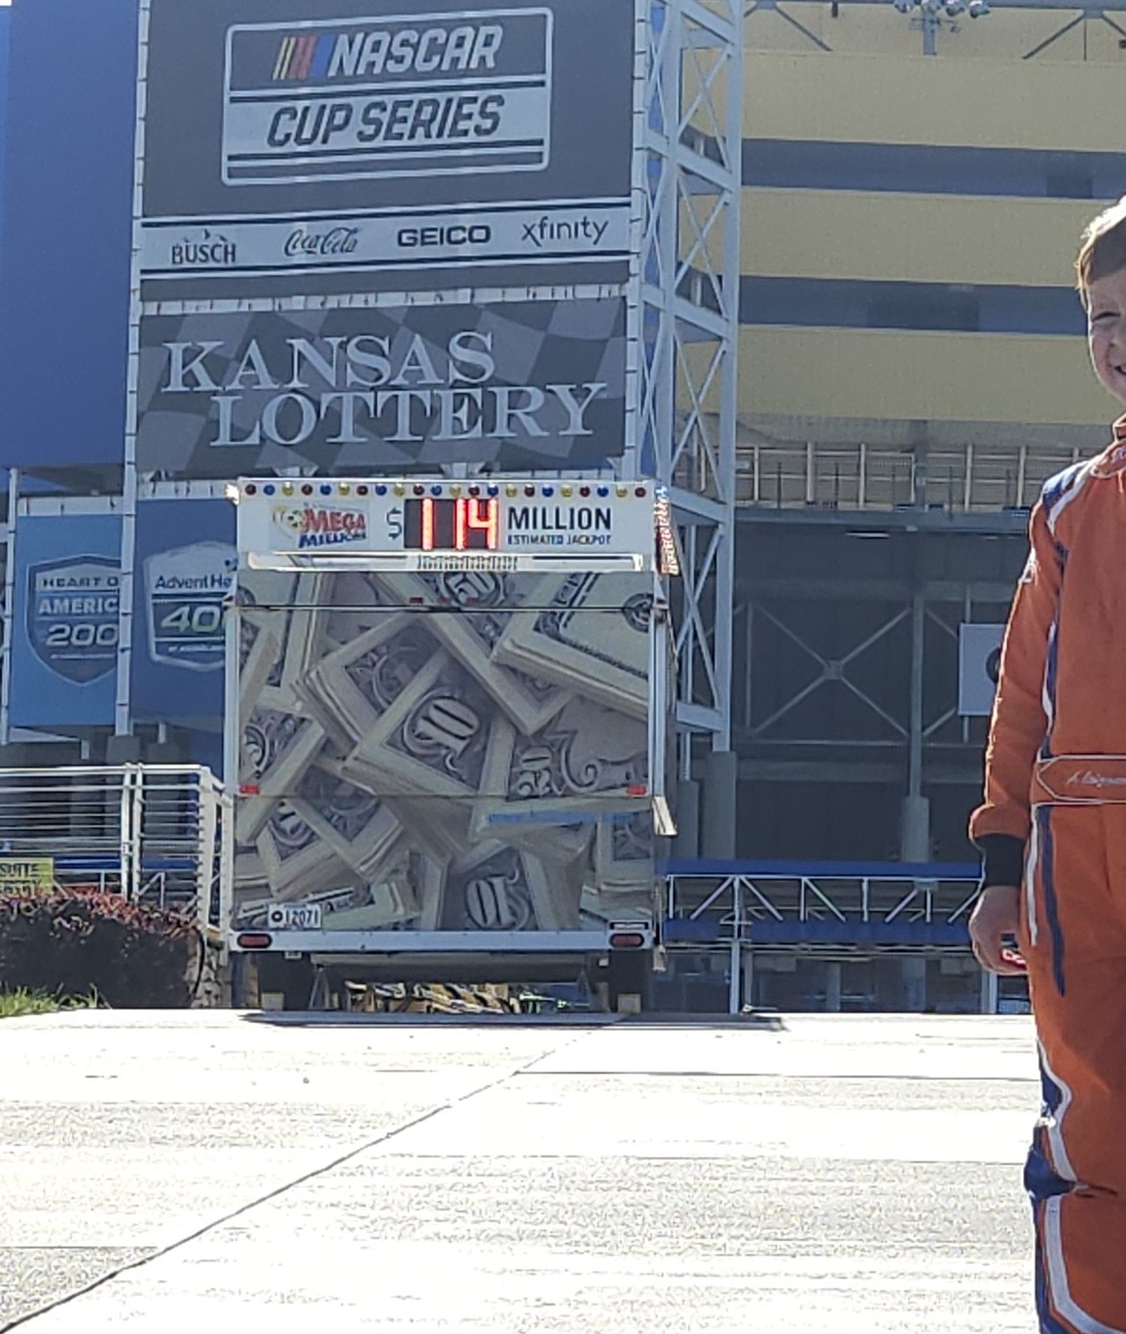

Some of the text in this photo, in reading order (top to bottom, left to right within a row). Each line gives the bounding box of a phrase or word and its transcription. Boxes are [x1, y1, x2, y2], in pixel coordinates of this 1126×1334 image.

[327, 25, 504, 78] NASCAR
[267, 95, 505, 147] CUP SERIES
[171, 242, 237, 265] BUSCH
[398, 225, 491, 247] GEICO
[521, 215, 609, 248] xfinity
[161, 331, 495, 393] KANSAS
[209, 382, 607, 447] LOTTERY
[302, 508, 367, 533] MEGA
[508, 506, 611, 530] MILLION
[507, 534, 563, 545] ESTIMATED
[43, 575, 101, 589] HEART
[161, 605, 225, 634] 40
[46, 624, 119, 647] 200
